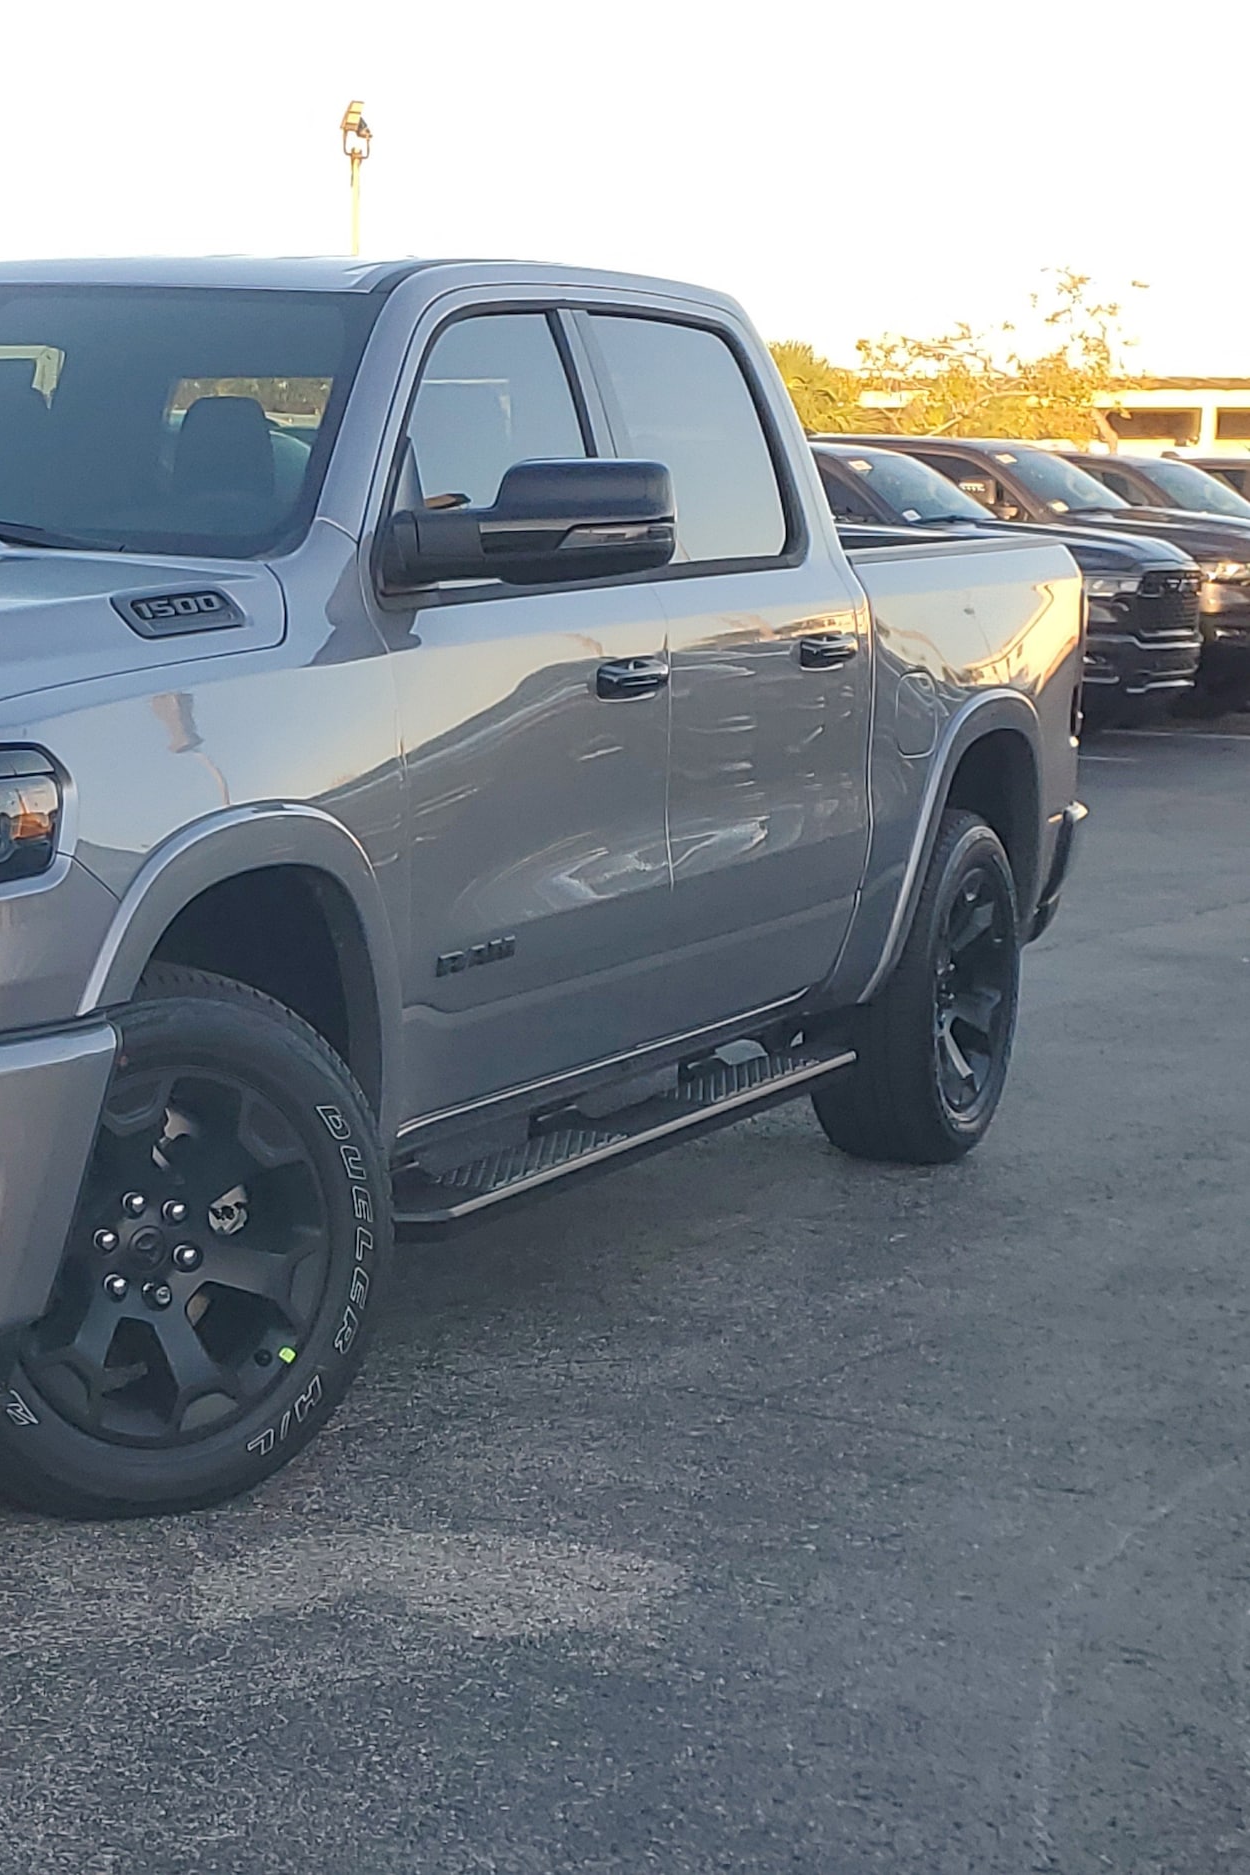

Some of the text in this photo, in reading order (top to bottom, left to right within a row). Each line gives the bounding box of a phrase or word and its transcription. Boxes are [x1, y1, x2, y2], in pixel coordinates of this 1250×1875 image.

[136, 595, 223, 619] 1500
[435, 935, 516, 978] RAM
[246, 1104, 375, 1456] DUELER H/L
